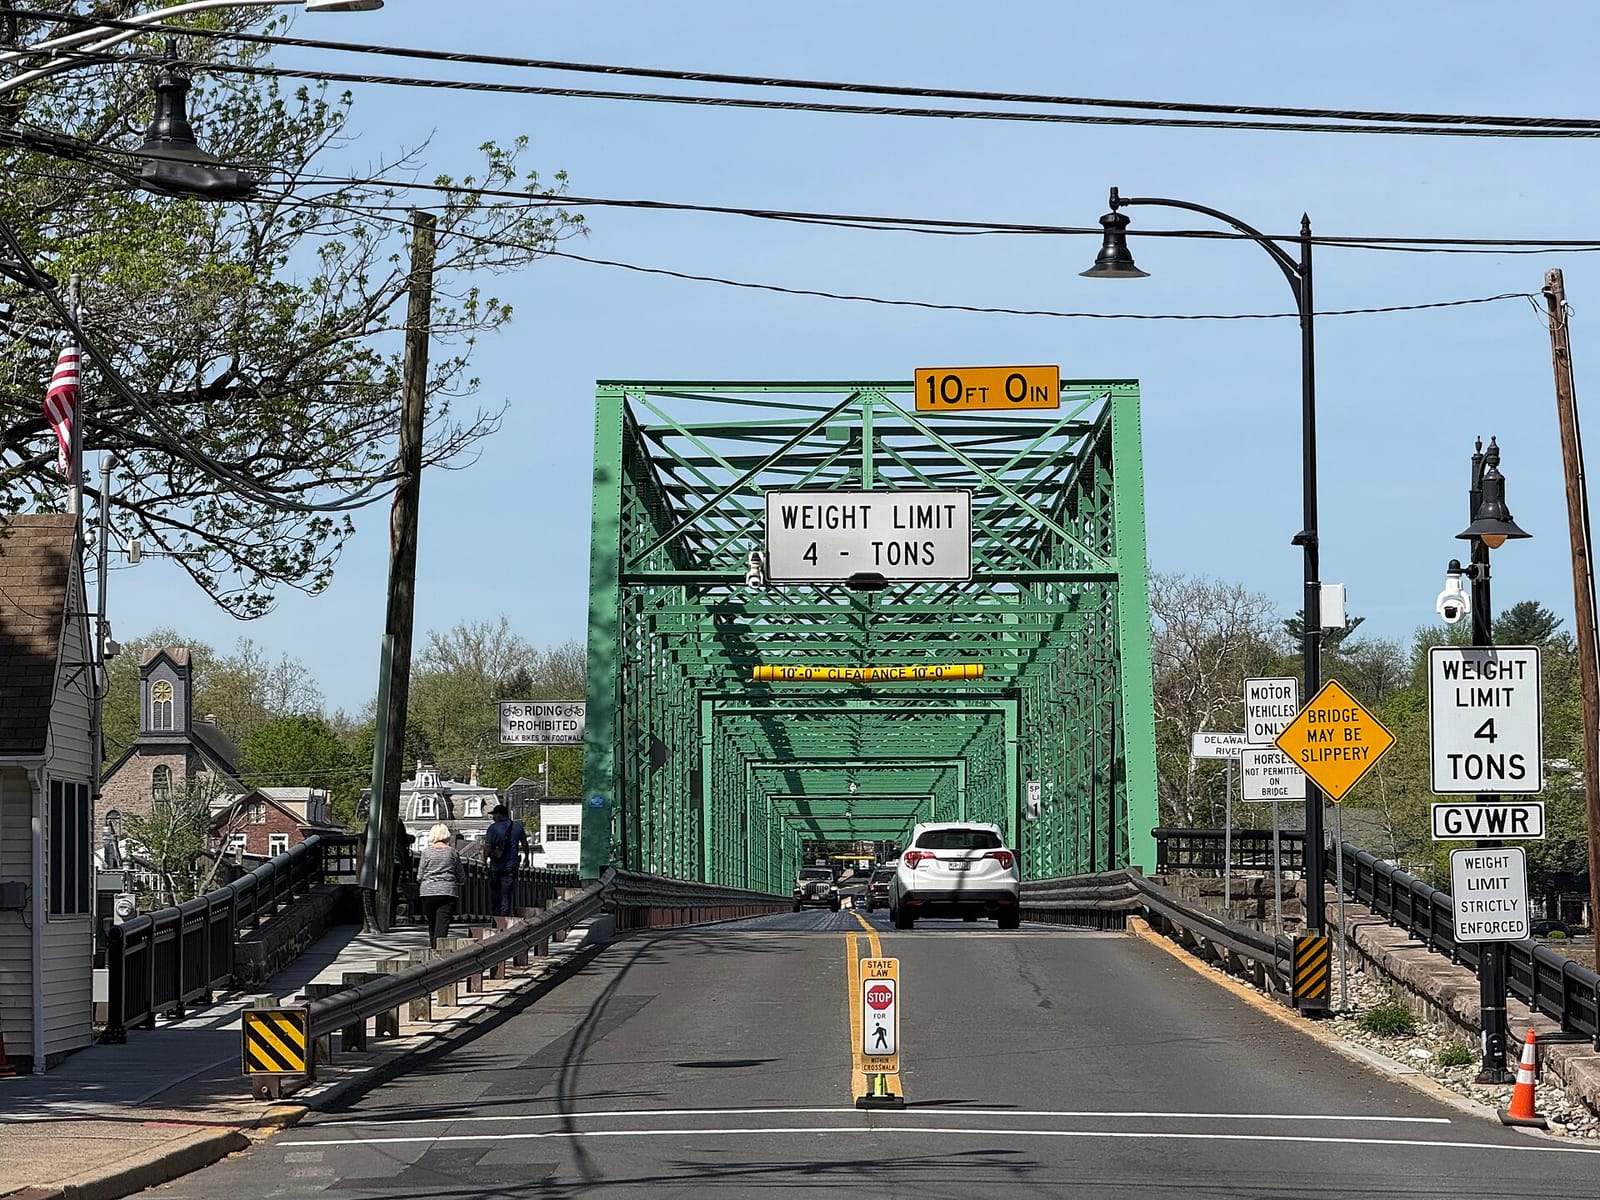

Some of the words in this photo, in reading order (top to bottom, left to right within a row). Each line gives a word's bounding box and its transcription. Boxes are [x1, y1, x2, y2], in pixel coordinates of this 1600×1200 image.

[781, 505, 871, 529] WEIGHT
[893, 505, 956, 529] LIMIT
[802, 542, 818, 566] 4
[871, 541, 935, 566] TONS
[1442, 660, 1527, 680] WEIGHT
[1251, 686, 1291, 700] MOTOR
[1456, 687, 1514, 707] LIMIT
[524, 705, 562, 717] RIDING
[1249, 704, 1295, 718] VEHICLES
[1307, 708, 1359, 723] BRIDGE
[509, 720, 578, 731] PROHIBITED
[1474, 718, 1498, 744] 4
[1307, 728, 1335, 743] MAY
[1344, 728, 1362, 742] BE
[1301, 746, 1369, 763] SLIPPERY
[1245, 767, 1260, 776] NOT
[1447, 753, 1526, 780] TONS
[1269, 777, 1280, 786] ON
[1261, 787, 1288, 796] BRIDGE
[1444, 808, 1529, 834] GVWR
[1464, 856, 1509, 869] WEIGHT
[1467, 877, 1510, 891] LIMIT
[1461, 899, 1518, 913] STRICTLY
[1460, 920, 1524, 934] ENFORCED
[867, 960, 892, 969] STATE
[871, 969, 888, 977] LAW
[868, 992, 892, 1003] STOP
